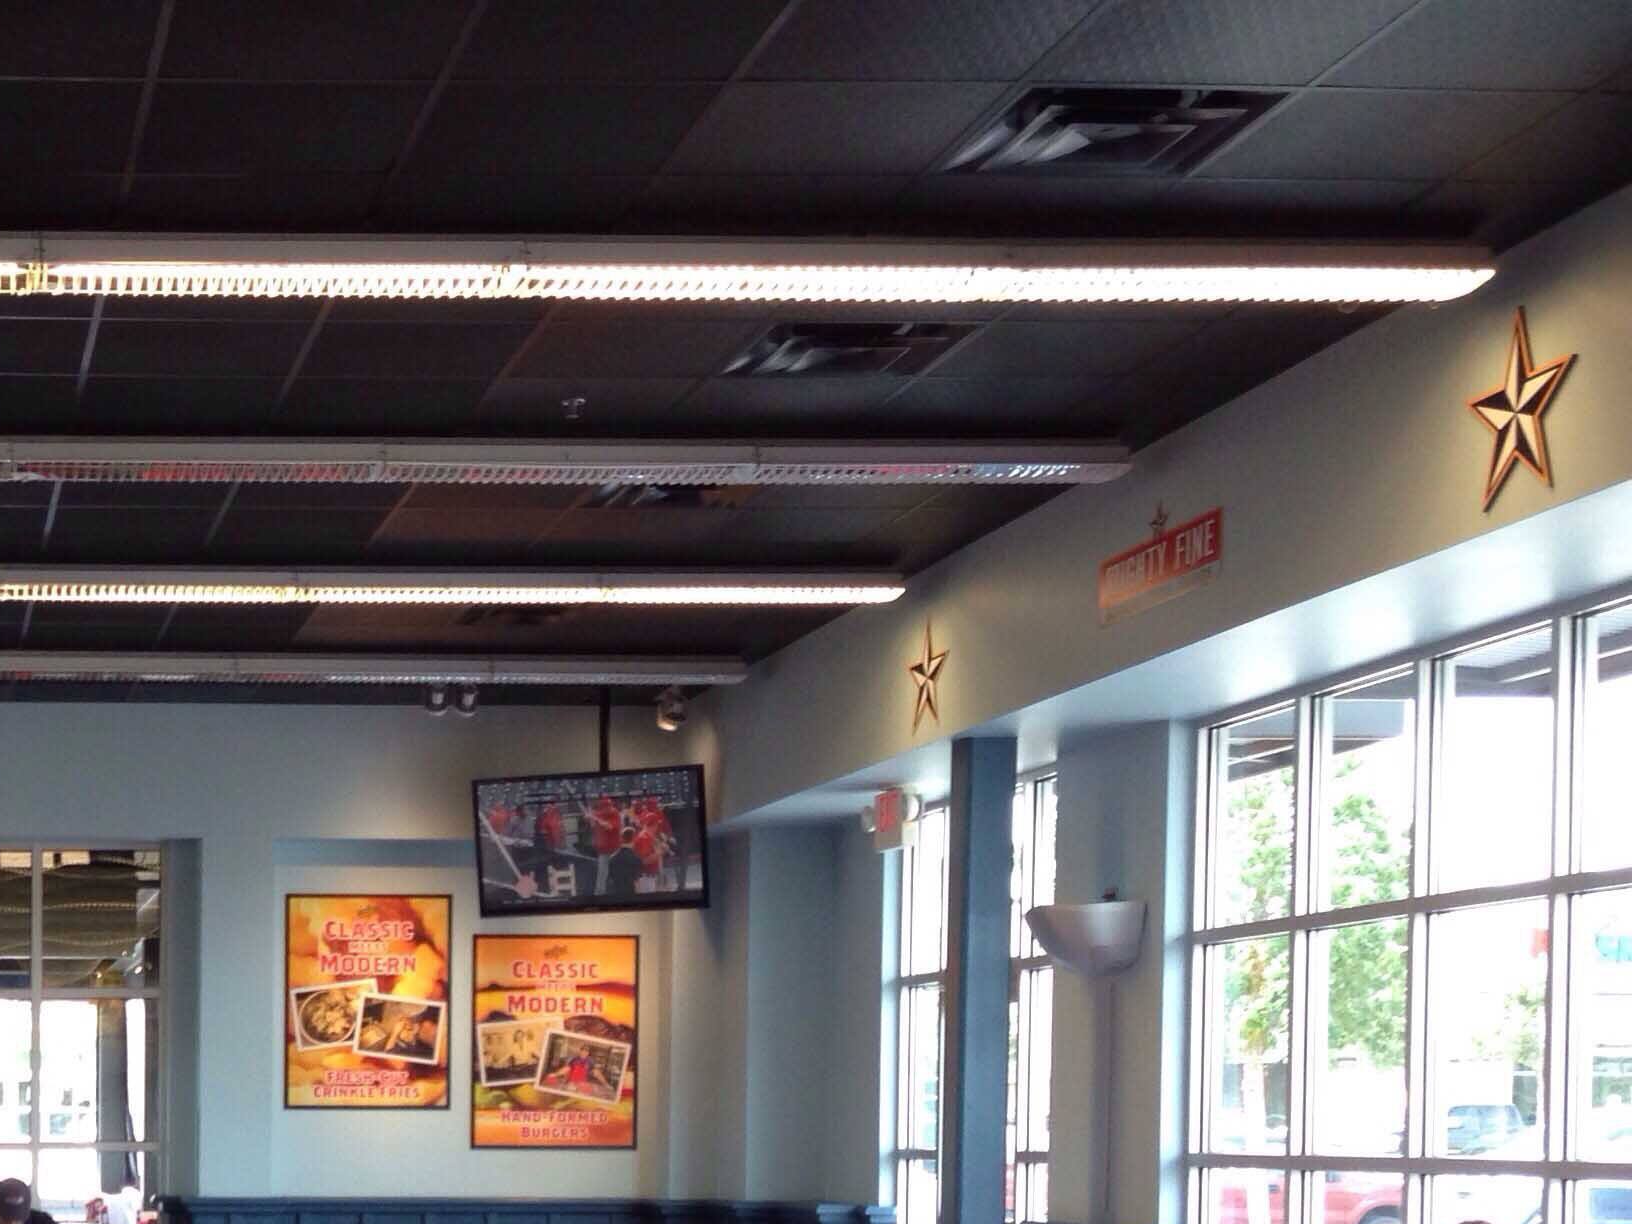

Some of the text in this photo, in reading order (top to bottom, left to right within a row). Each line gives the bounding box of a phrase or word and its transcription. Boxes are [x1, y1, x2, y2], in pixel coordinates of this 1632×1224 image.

[1175, 519, 1217, 571] FINE
[324, 920, 415, 939] CLASSIC
[320, 954, 417, 974] MODERN
[511, 961, 599, 979] CLASSIC
[507, 995, 604, 1013] MODERN
[520, 1126, 590, 1139] BURGERS
